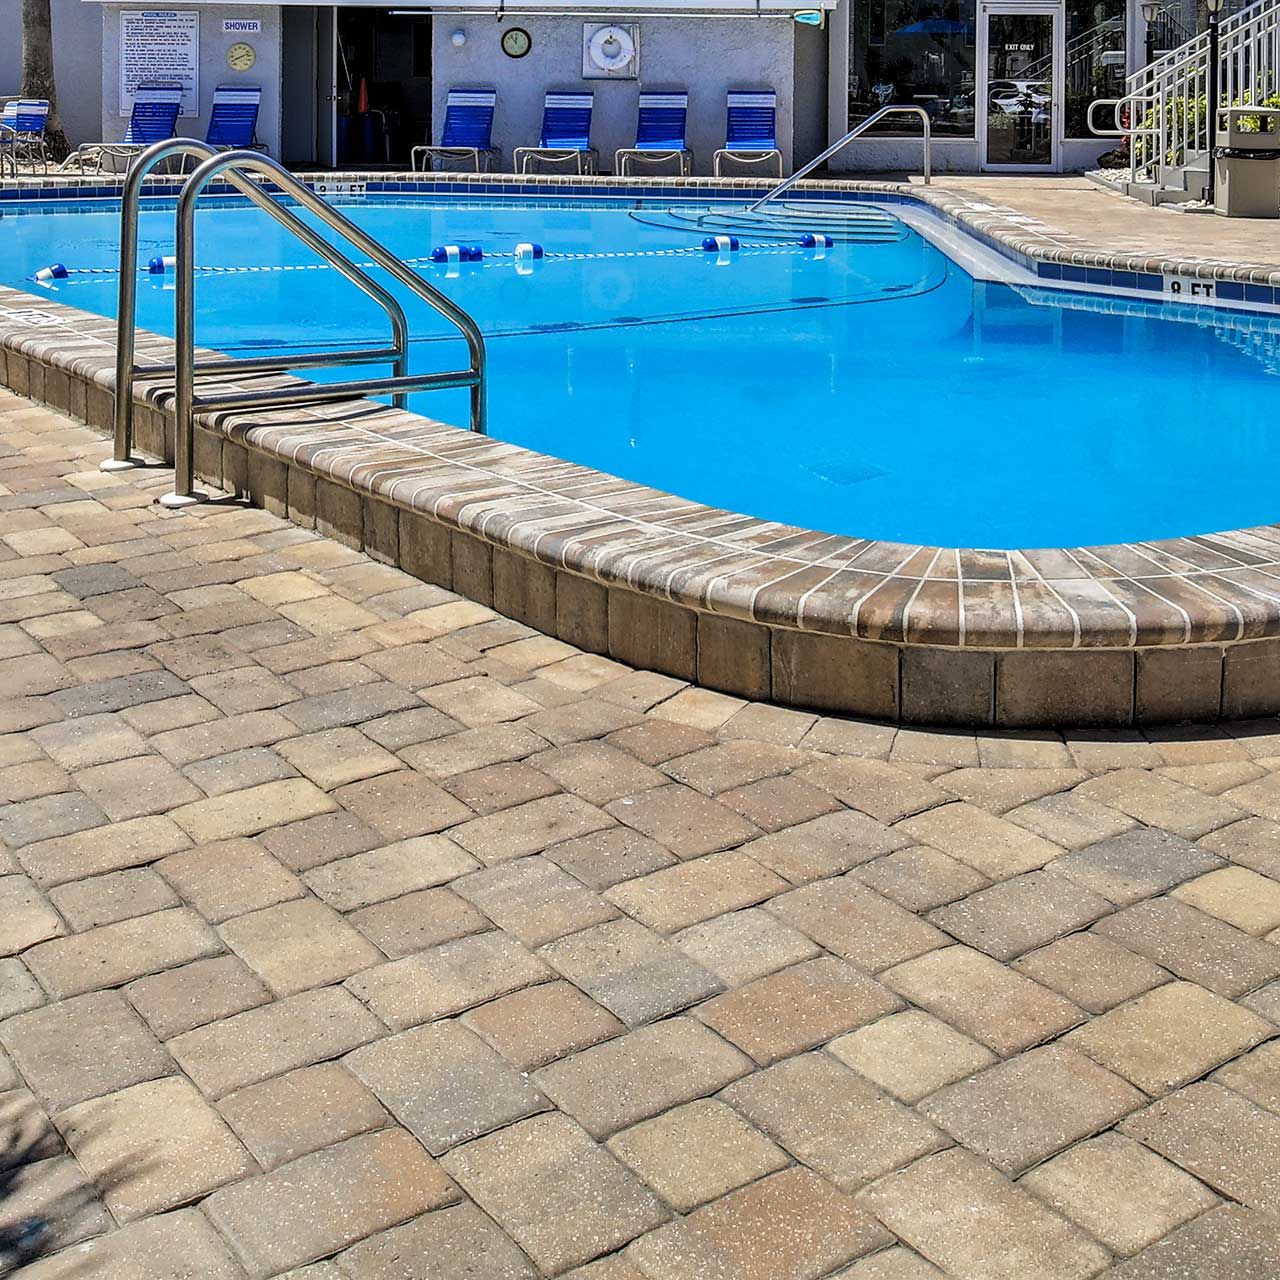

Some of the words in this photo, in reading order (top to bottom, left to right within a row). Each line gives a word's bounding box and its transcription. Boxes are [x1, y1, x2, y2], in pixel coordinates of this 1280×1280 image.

[224, 22, 258, 30] SHOWER
[1171, 281, 1181, 293] 8
[1191, 283, 1213, 297] FT
